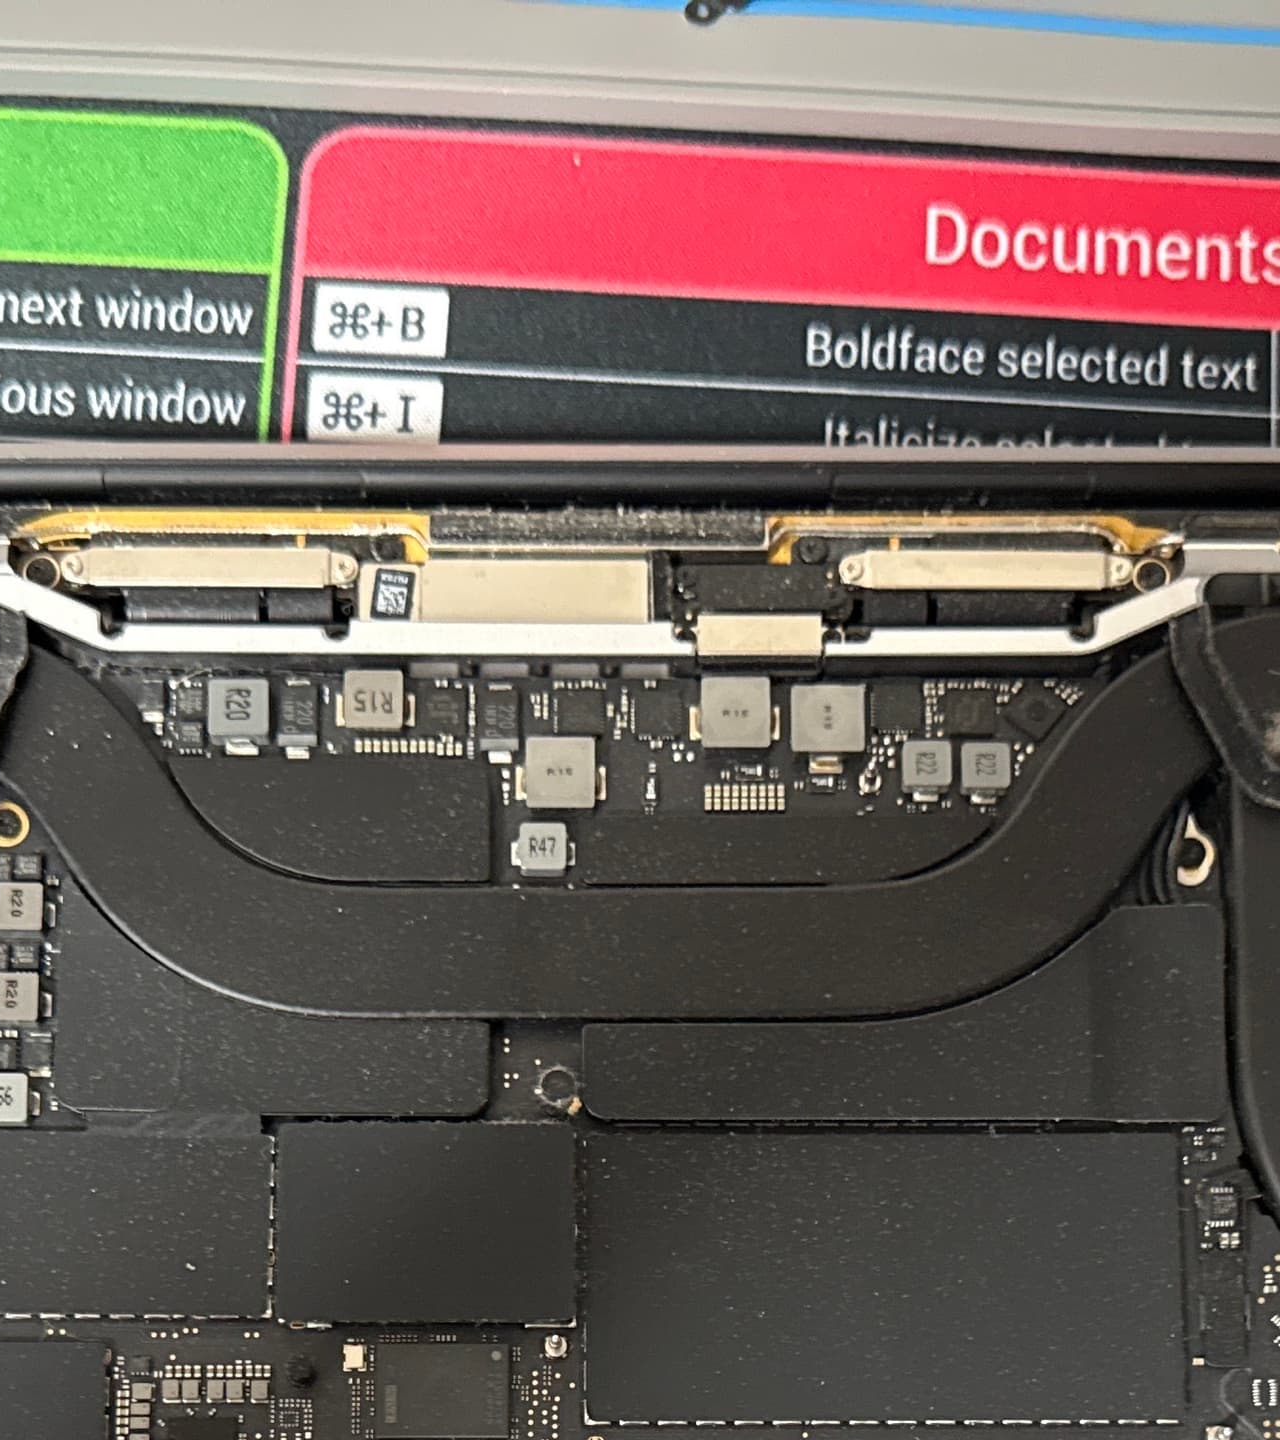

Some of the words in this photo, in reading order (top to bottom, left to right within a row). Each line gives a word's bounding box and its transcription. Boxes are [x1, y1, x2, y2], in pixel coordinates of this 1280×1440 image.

[97, 292, 253, 335] window
[806, 322, 985, 376] Boldface
[997, 337, 1168, 388] selected
[1181, 350, 1258, 393] text
[89, 380, 246, 425] window
[529, 837, 556, 857] R47
